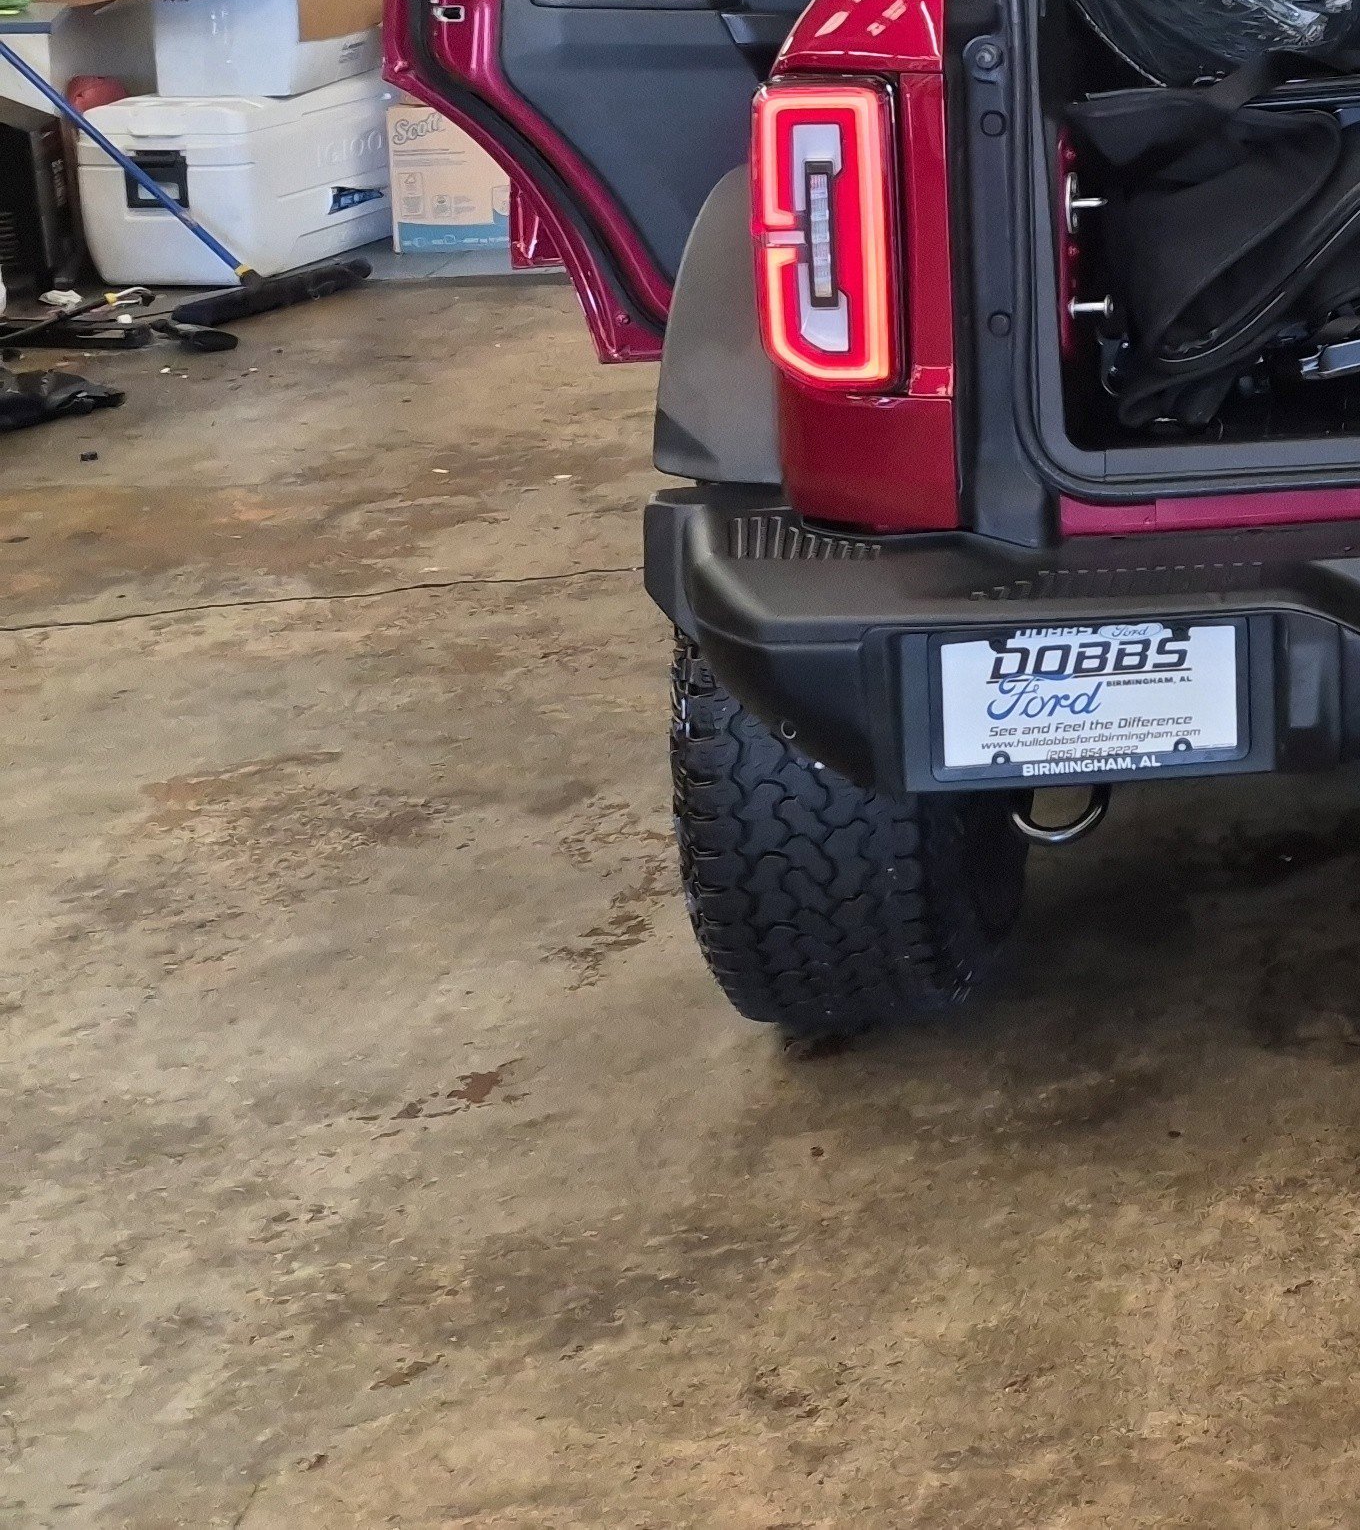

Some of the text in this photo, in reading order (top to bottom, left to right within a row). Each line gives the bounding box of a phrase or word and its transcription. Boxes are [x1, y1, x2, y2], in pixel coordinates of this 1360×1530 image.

[393, 112, 446, 145] Scott
[1111, 624, 1150, 638] Ford
[990, 636, 1191, 680] DOBBS
[1106, 676, 1176, 687] BIRMINGHAM,
[987, 673, 1103, 721] Ford
[989, 716, 1193, 737] See and Feel the Difference
[981, 729, 1201, 750] www.hulldobbsfordbirmingham.com
[1046, 745, 1139, 759] (205) 854-2222
[1022, 755, 1162, 777] BIRMINGHAM, AL
